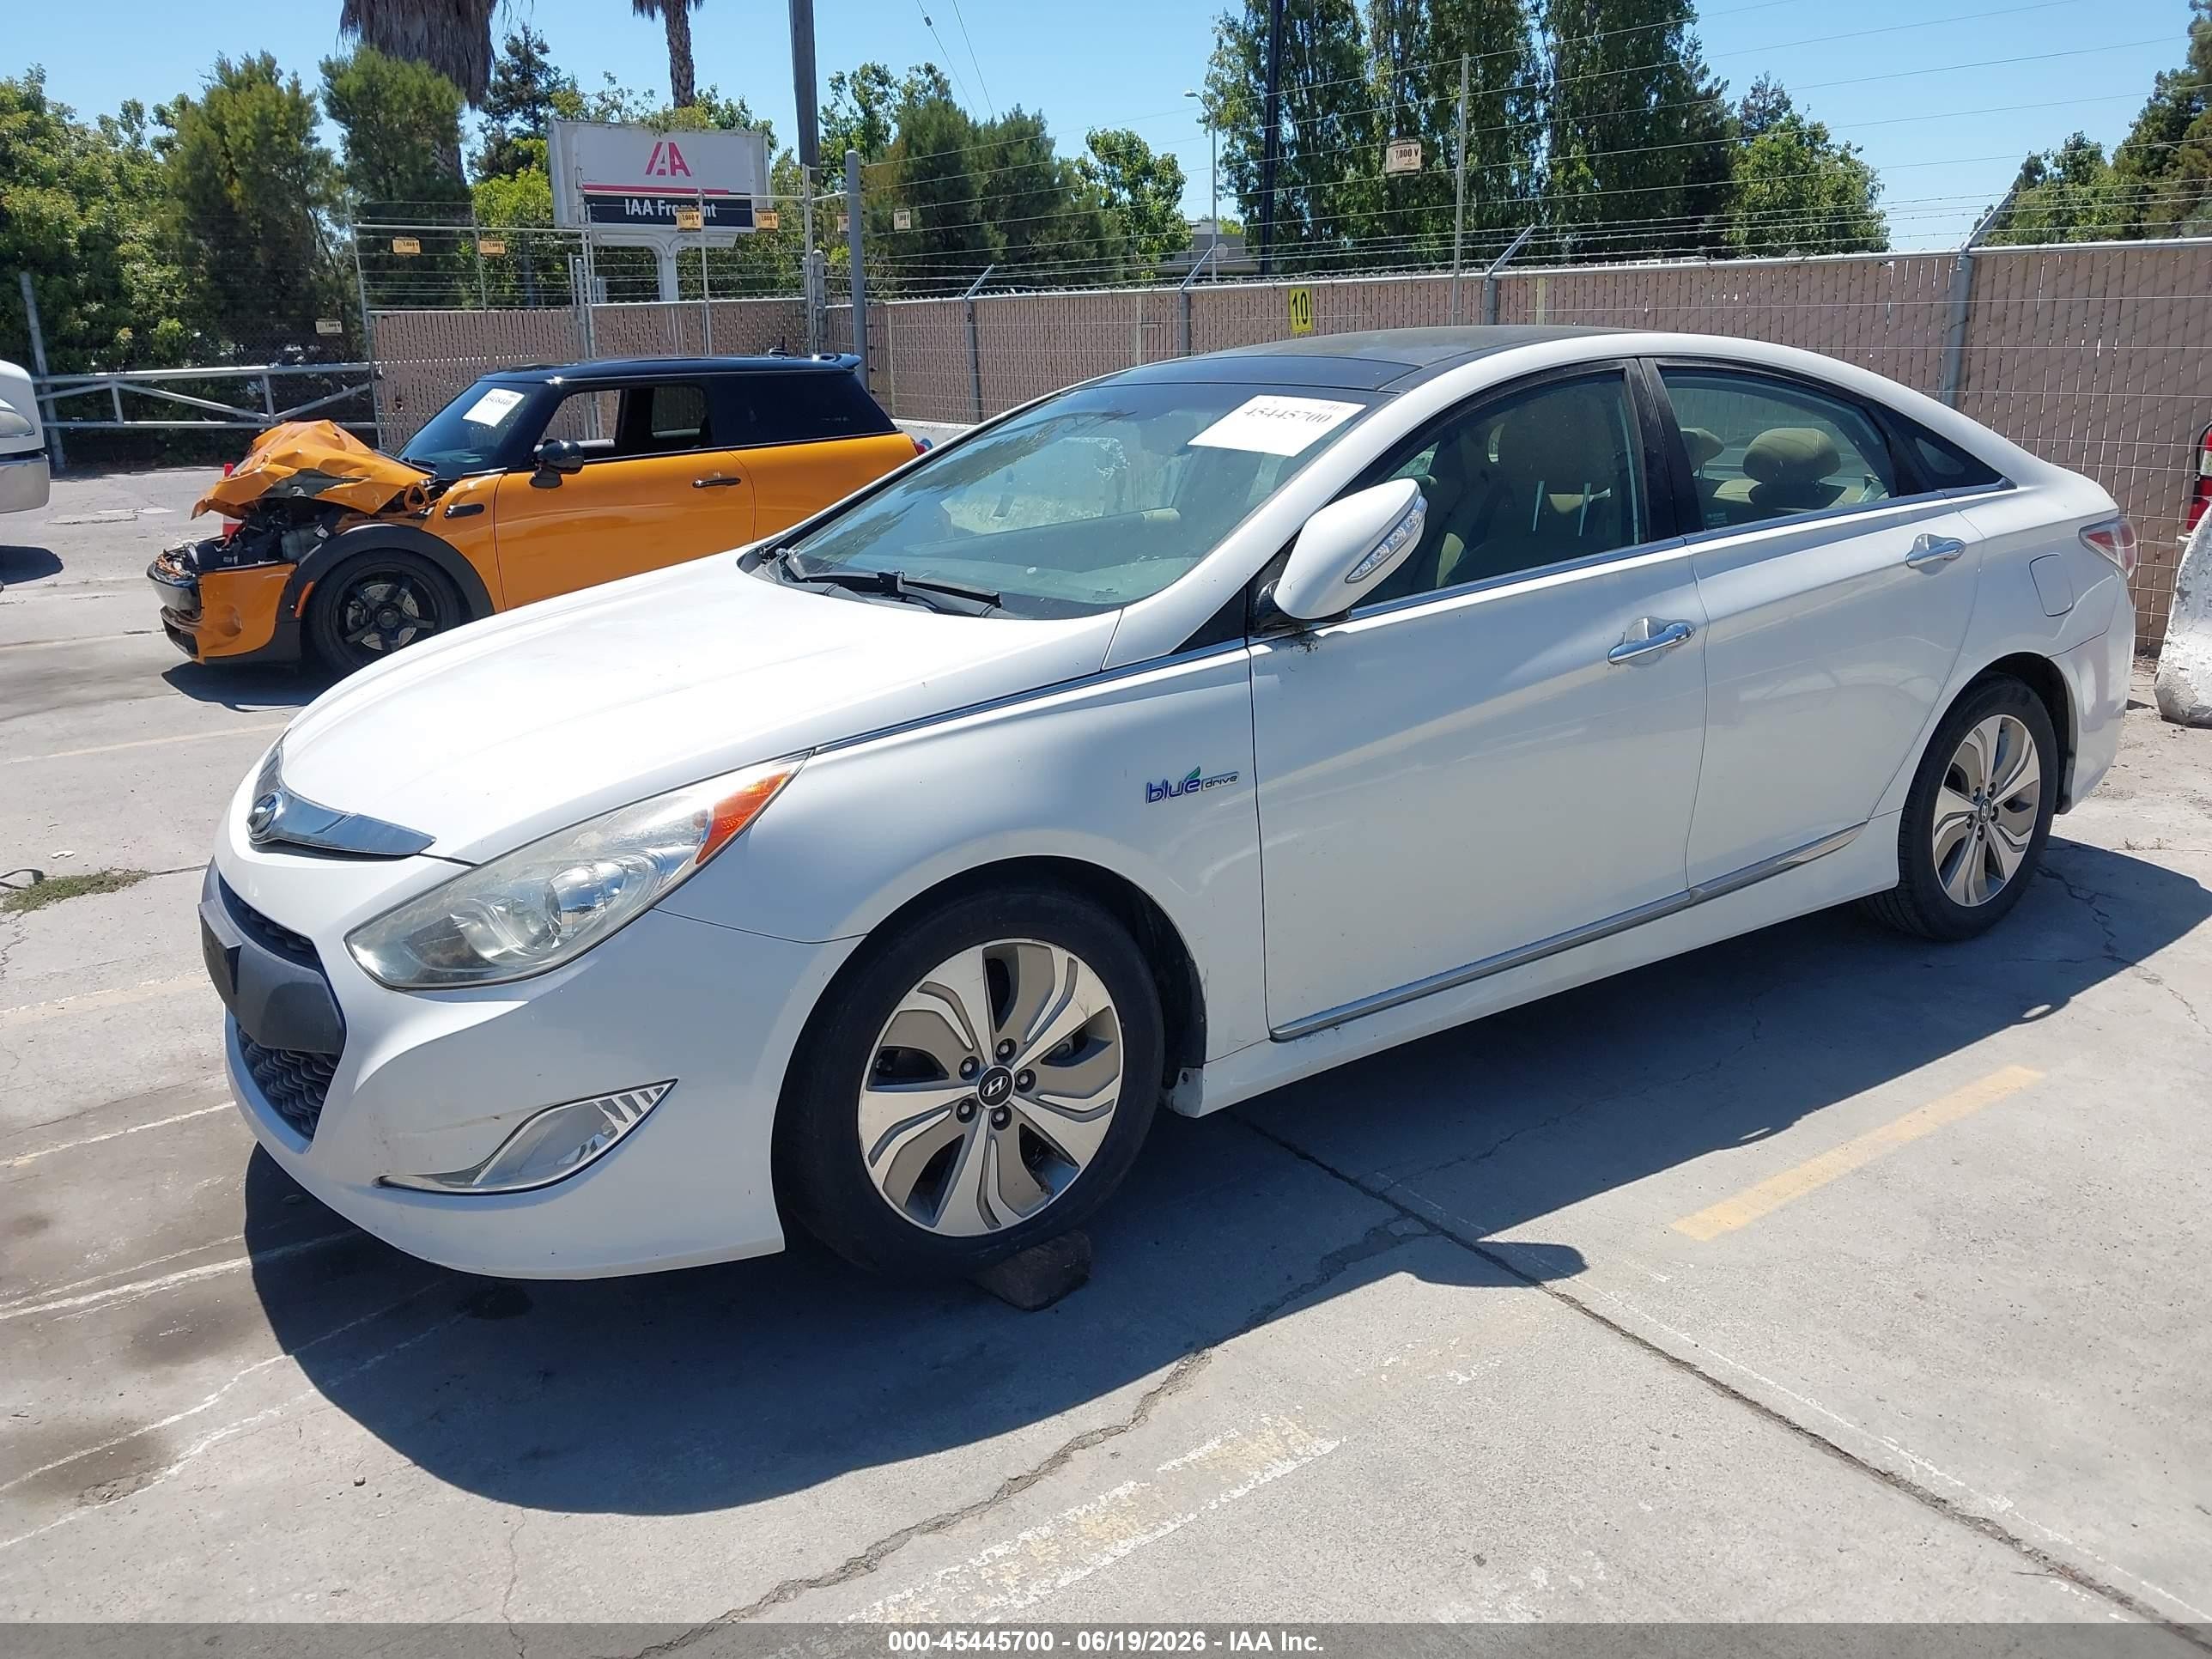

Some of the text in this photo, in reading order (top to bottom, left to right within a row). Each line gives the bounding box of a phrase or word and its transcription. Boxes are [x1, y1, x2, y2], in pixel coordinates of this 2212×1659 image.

[1395, 148, 1419, 160] 7,000 V
[624, 198, 717, 218] IAA Frent
[967, 313, 972, 323] 9
[1292, 291, 1309, 326] 10
[1146, 775, 1238, 805] blue drive
